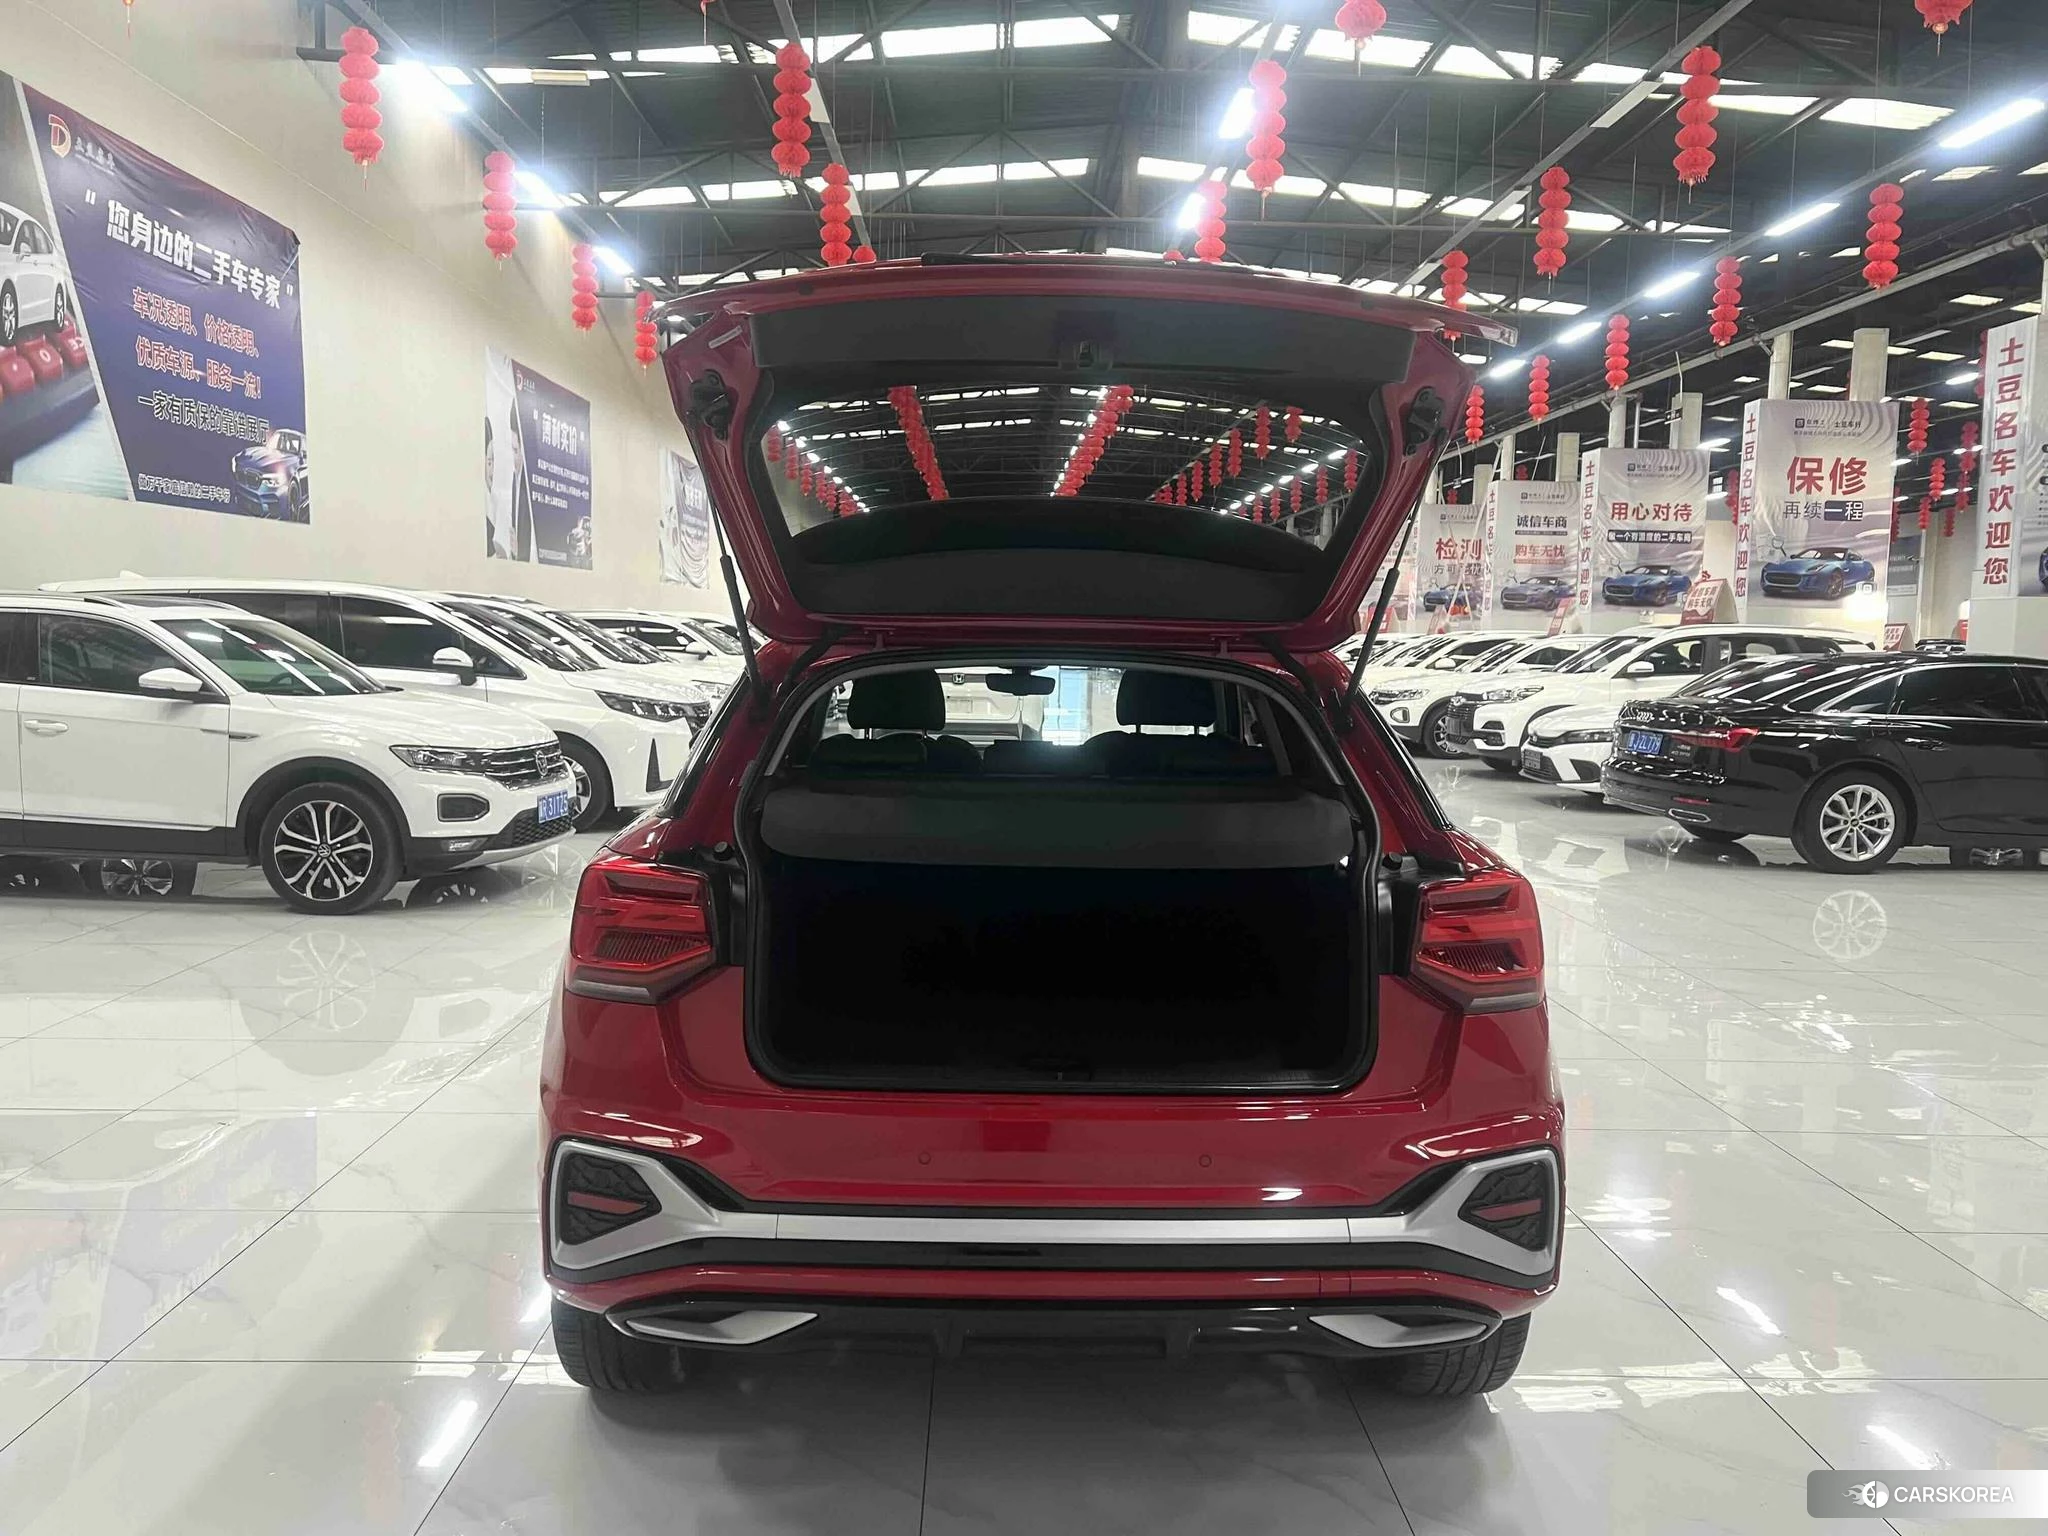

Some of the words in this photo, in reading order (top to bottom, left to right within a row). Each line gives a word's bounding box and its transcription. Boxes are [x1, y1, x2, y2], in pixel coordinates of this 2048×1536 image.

[1983, 337, 2024, 586] 土豆名车欢迎您
[1786, 455, 1868, 496] 保修
[1610, 502, 1693, 521] 用心对待
[1735, 412, 1757, 598] 土豆名车欢迎您
[1783, 500, 1864, 522] 再续一程
[1516, 514, 1568, 529] 诚信车商
[1579, 460, 1596, 606] 土豆名车欢迎您
[1435, 537, 1482, 560] 检测
[1515, 544, 1566, 558] 购车无忧
